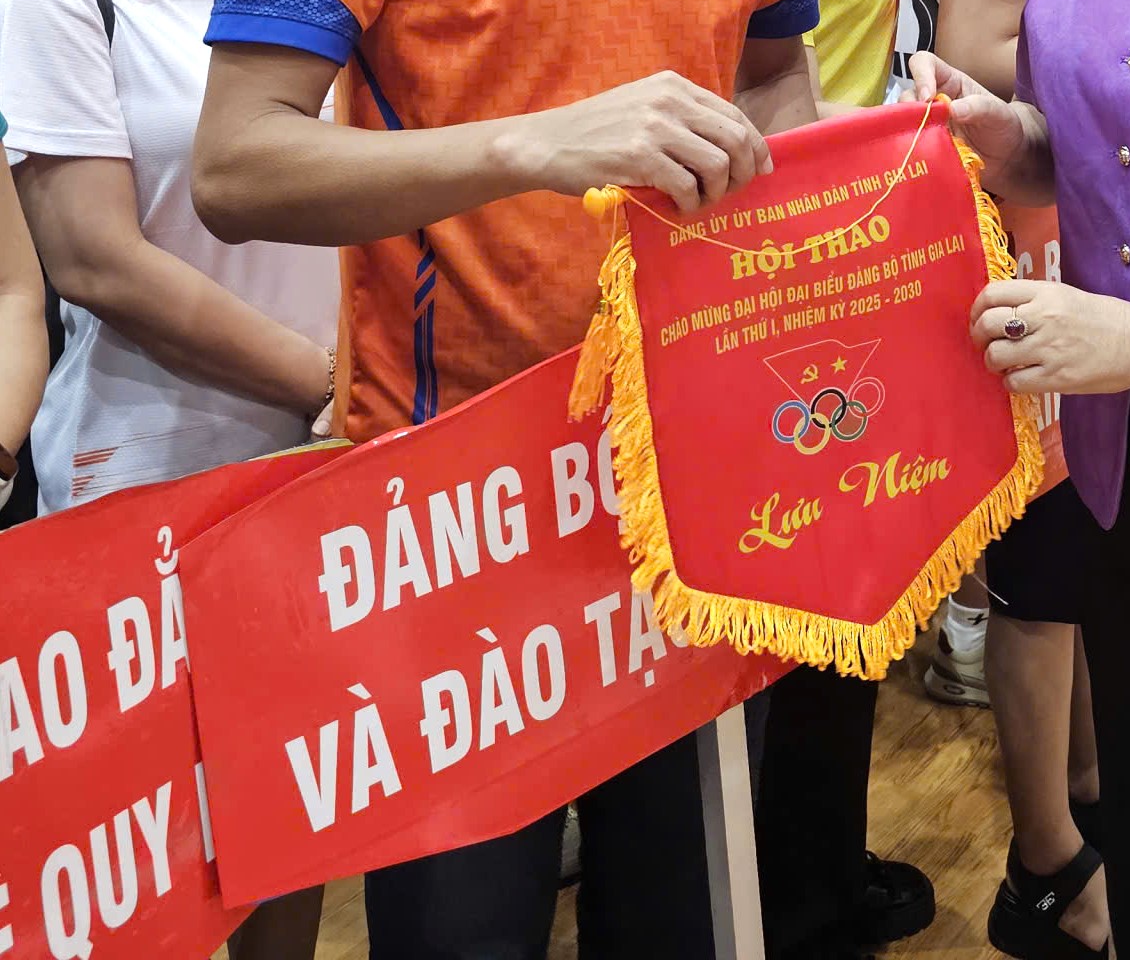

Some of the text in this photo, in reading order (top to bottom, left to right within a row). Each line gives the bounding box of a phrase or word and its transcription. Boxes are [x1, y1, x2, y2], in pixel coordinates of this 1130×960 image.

[756, 204, 785, 225] BAN
[786, 193, 822, 218] NHÂN
[823, 184, 850, 208] DÂN
[884, 167, 905, 187] GIA
[908, 159, 929, 179] LAI
[660, 316, 689, 347] CHÀO
[691, 304, 732, 332] MỪNG
[734, 296, 756, 319] ĐẠI
[759, 286, 783, 312] HỘI
[786, 284, 809, 305] ĐẠI
[813, 270, 844, 298] BIỂU
[847, 265, 881, 290] ĐẢNG
[882, 254, 899, 280] BỘ
[928, 242, 945, 262] GIA
[945, 234, 965, 254] LAI
[730, 215, 891, 280] HỘI THAO
[715, 327, 740, 355] LẦN
[742, 318, 768, 345] THỨ
[783, 306, 826, 333] NHIỆM
[830, 299, 846, 321] KỲ
[850, 294, 881, 316] 2025
[893, 280, 922, 305] 2030
[318, 477, 529, 632] ĐẢNG
[738, 451, 952, 554] Lưu Niệm
[284, 683, 402, 833] VÀ
[420, 624, 567, 774] ĐÀO
[583, 586, 690, 688] TẠ
[40, 780, 173, 960] QUY
